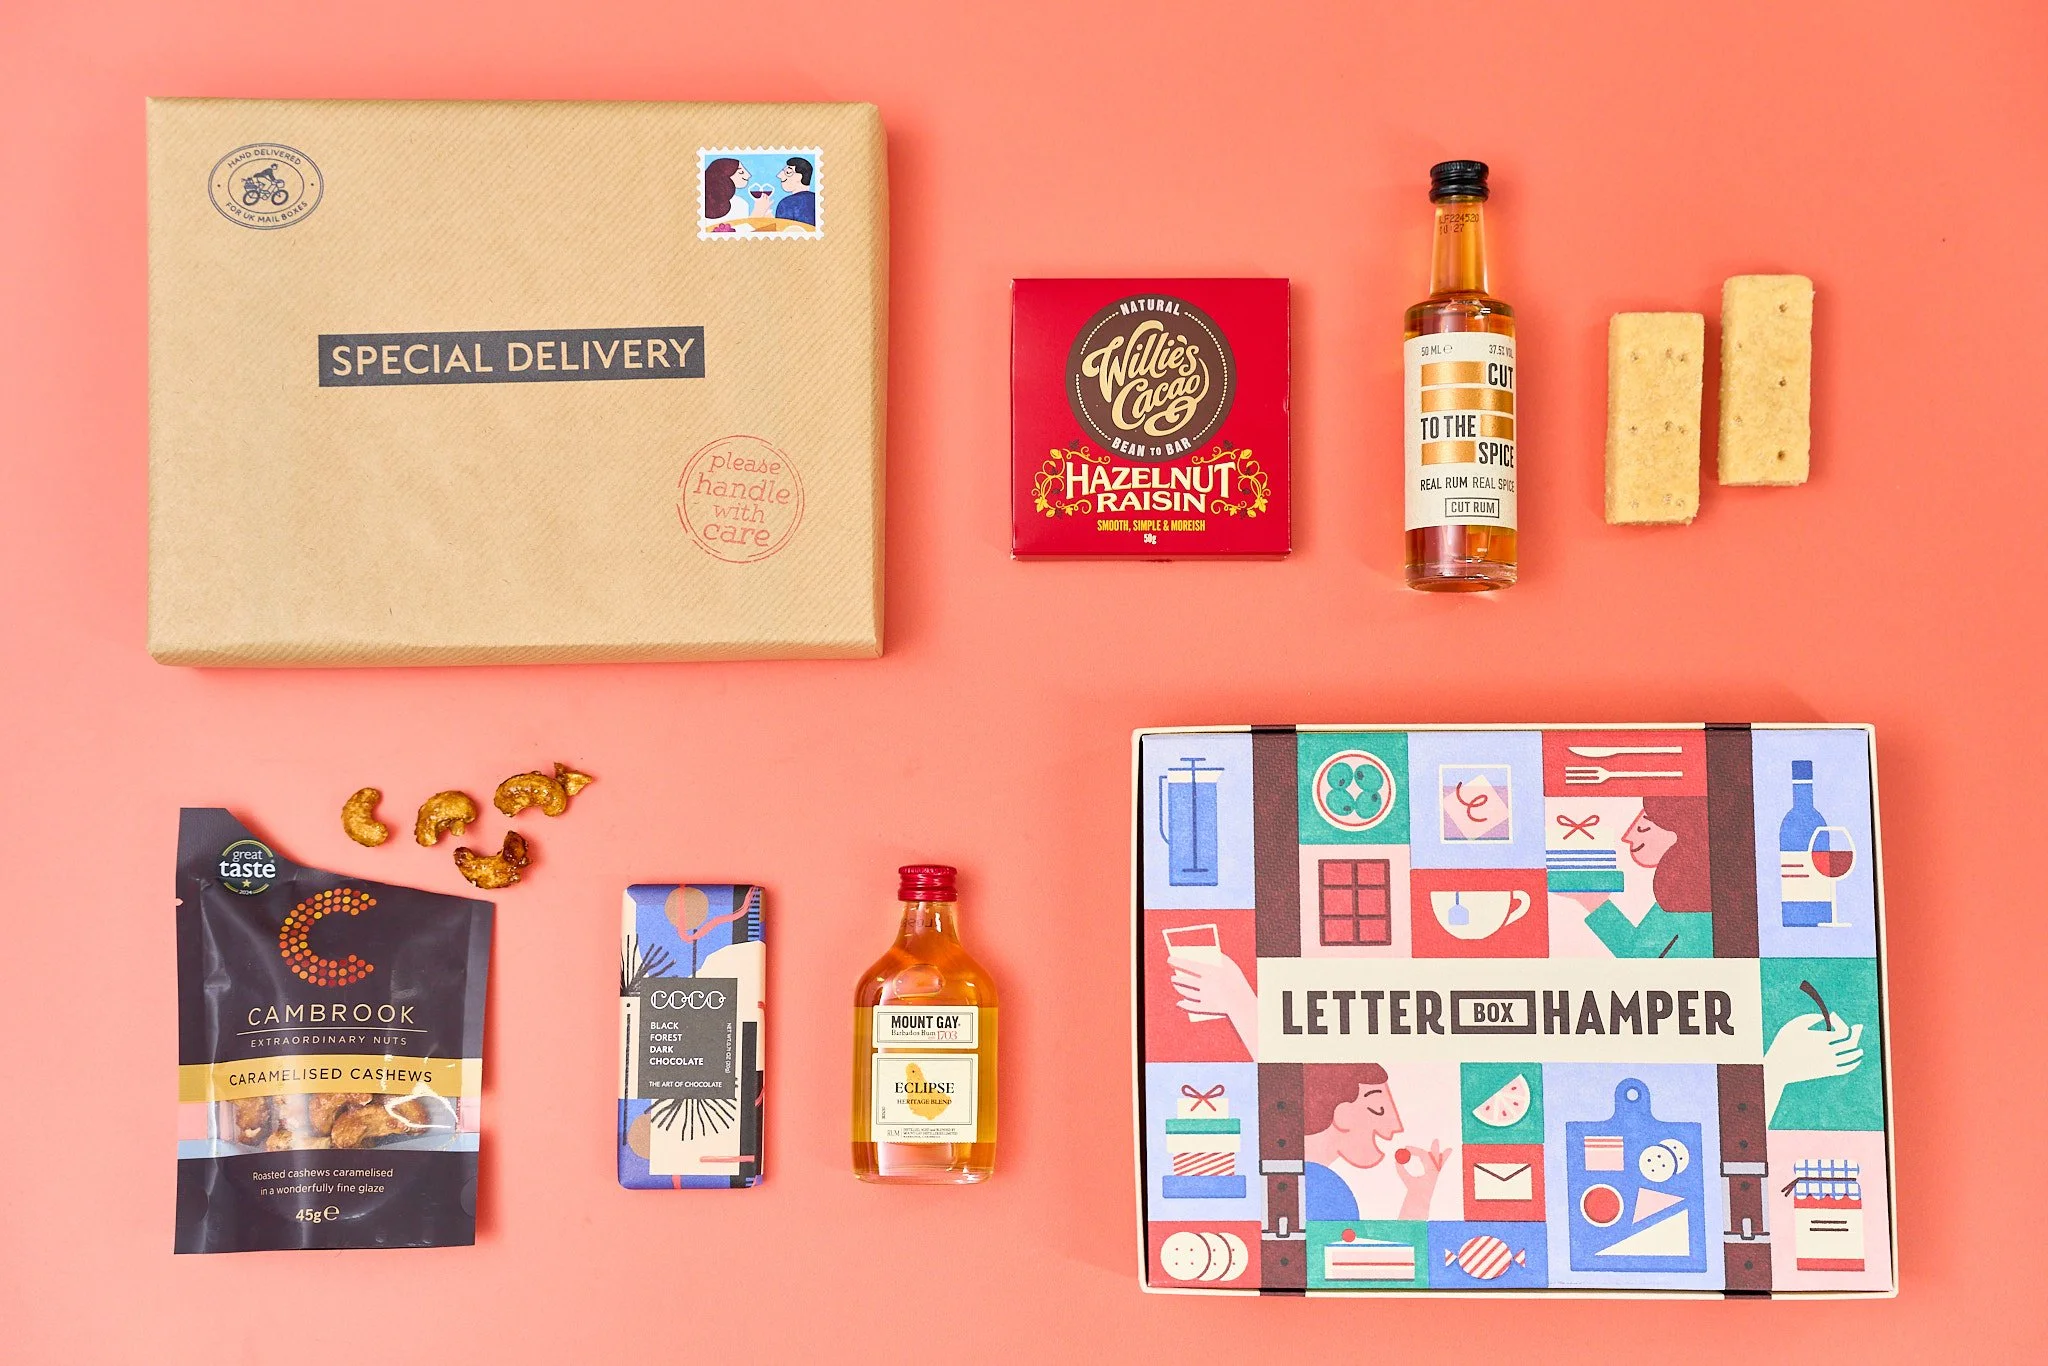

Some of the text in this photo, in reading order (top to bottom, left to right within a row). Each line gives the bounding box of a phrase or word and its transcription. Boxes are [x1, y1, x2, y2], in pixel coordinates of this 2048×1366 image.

[227, 148, 301, 168] HAND DELIVERED
[226, 201, 308, 223] FOR UK MAIL BOXES
[1120, 299, 1180, 316] NATURAL
[332, 338, 695, 377] SPECIAL DELIVERY
[1421, 346, 1429, 356] 50
[1431, 345, 1441, 355] ML
[1488, 362, 1513, 389] CUT
[1111, 358, 1210, 437] Cacao
[1420, 415, 1476, 440] TO THE
[1111, 437, 1192, 457] BEAN TO BAR
[1478, 442, 1514, 468] SPICE
[708, 452, 781, 475] please
[693, 472, 790, 504] handle
[1066, 461, 1236, 500] HAZELNUT
[1420, 477, 1515, 492] REAL RUM REAL SPICE
[1097, 491, 1207, 513] RAISIN
[1451, 501, 1495, 513] CUT RUM
[713, 502, 764, 523] with
[1097, 519, 1206, 533] SMOOTH, SIMPLE & MOREISH
[703, 523, 770, 547] care
[232, 850, 263, 863] great
[219, 861, 276, 878] taste
[248, 1003, 415, 1026] CAMBROOK
[1282, 990, 1735, 1036] LETTER BOX HAMPER
[650, 1022, 679, 1030] BLACK
[892, 1016, 959, 1028] MOUNT GAY
[251, 1035, 407, 1048] EXTRAORDINARY NUTS
[650, 1034, 683, 1042] FOREST
[937, 1030, 958, 1040] 1703
[649, 1057, 704, 1066] CHOCOLATE
[229, 1068, 433, 1086] CARAMELISED CASHEWS
[895, 1082, 955, 1094] ECLIPSE
[252, 1168, 394, 1180] Roasted cashews caramelised
[260, 1187, 268, 1196] in
[276, 1183, 334, 1194] wonderfully
[337, 1183, 356, 1192] fine
[358, 1183, 385, 1195] glaze
[295, 1208, 322, 1224] 45g
